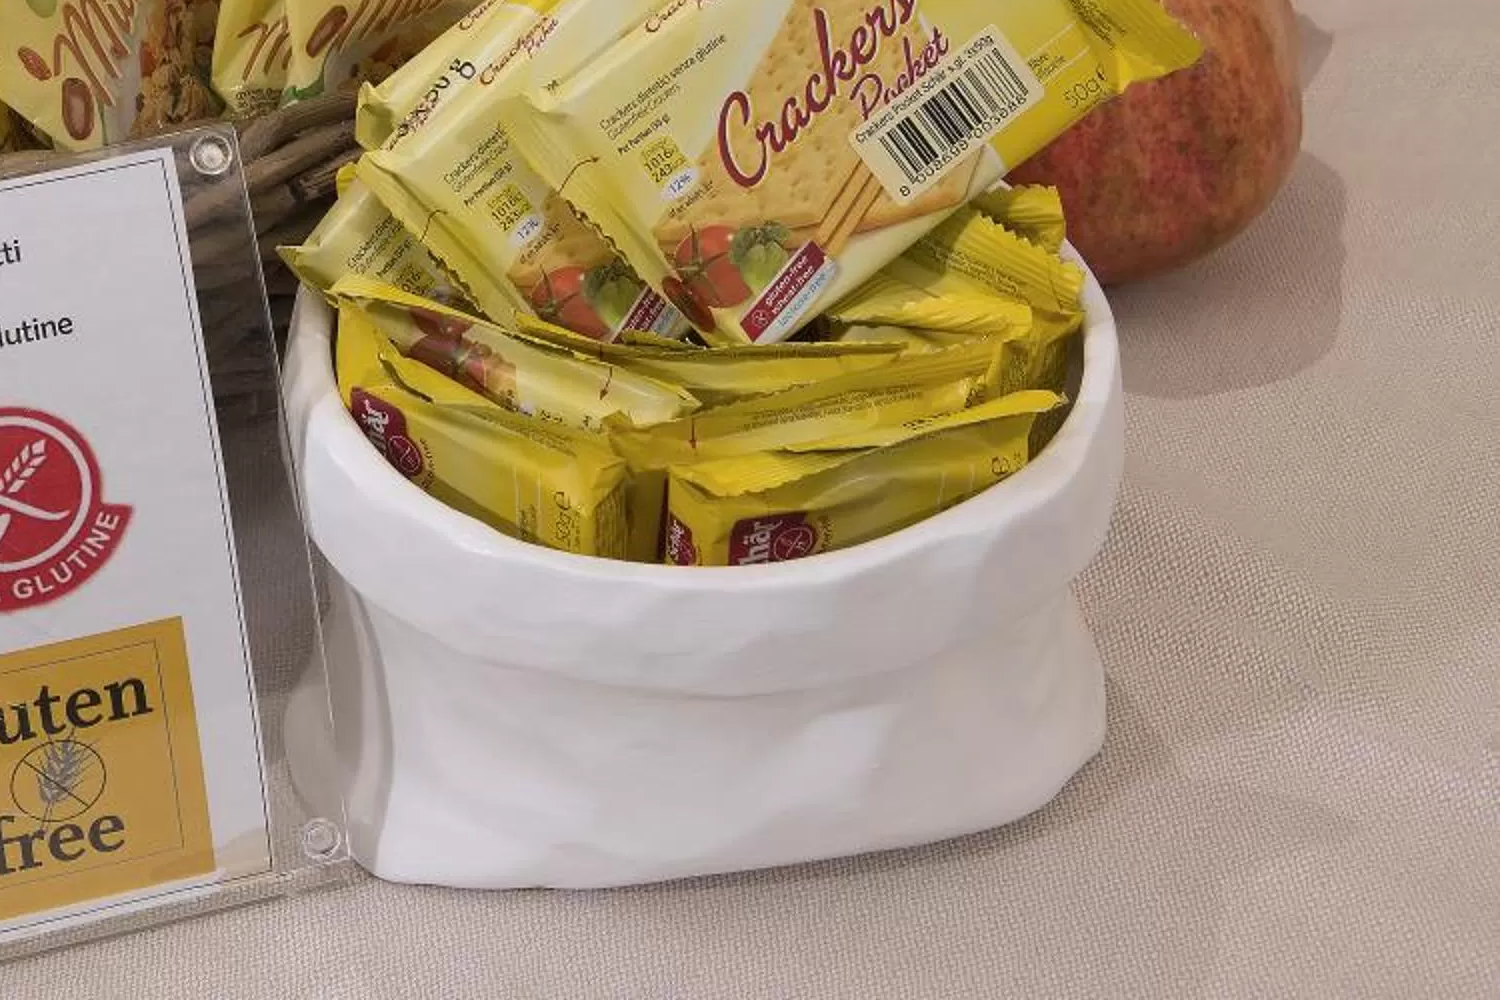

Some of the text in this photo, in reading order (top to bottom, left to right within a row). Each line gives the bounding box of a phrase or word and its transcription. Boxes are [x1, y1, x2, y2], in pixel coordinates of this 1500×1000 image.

[850, 26, 949, 121] Pocket
[12, 510, 121, 600] GLUTINE
[736, 519, 784, 567] här
